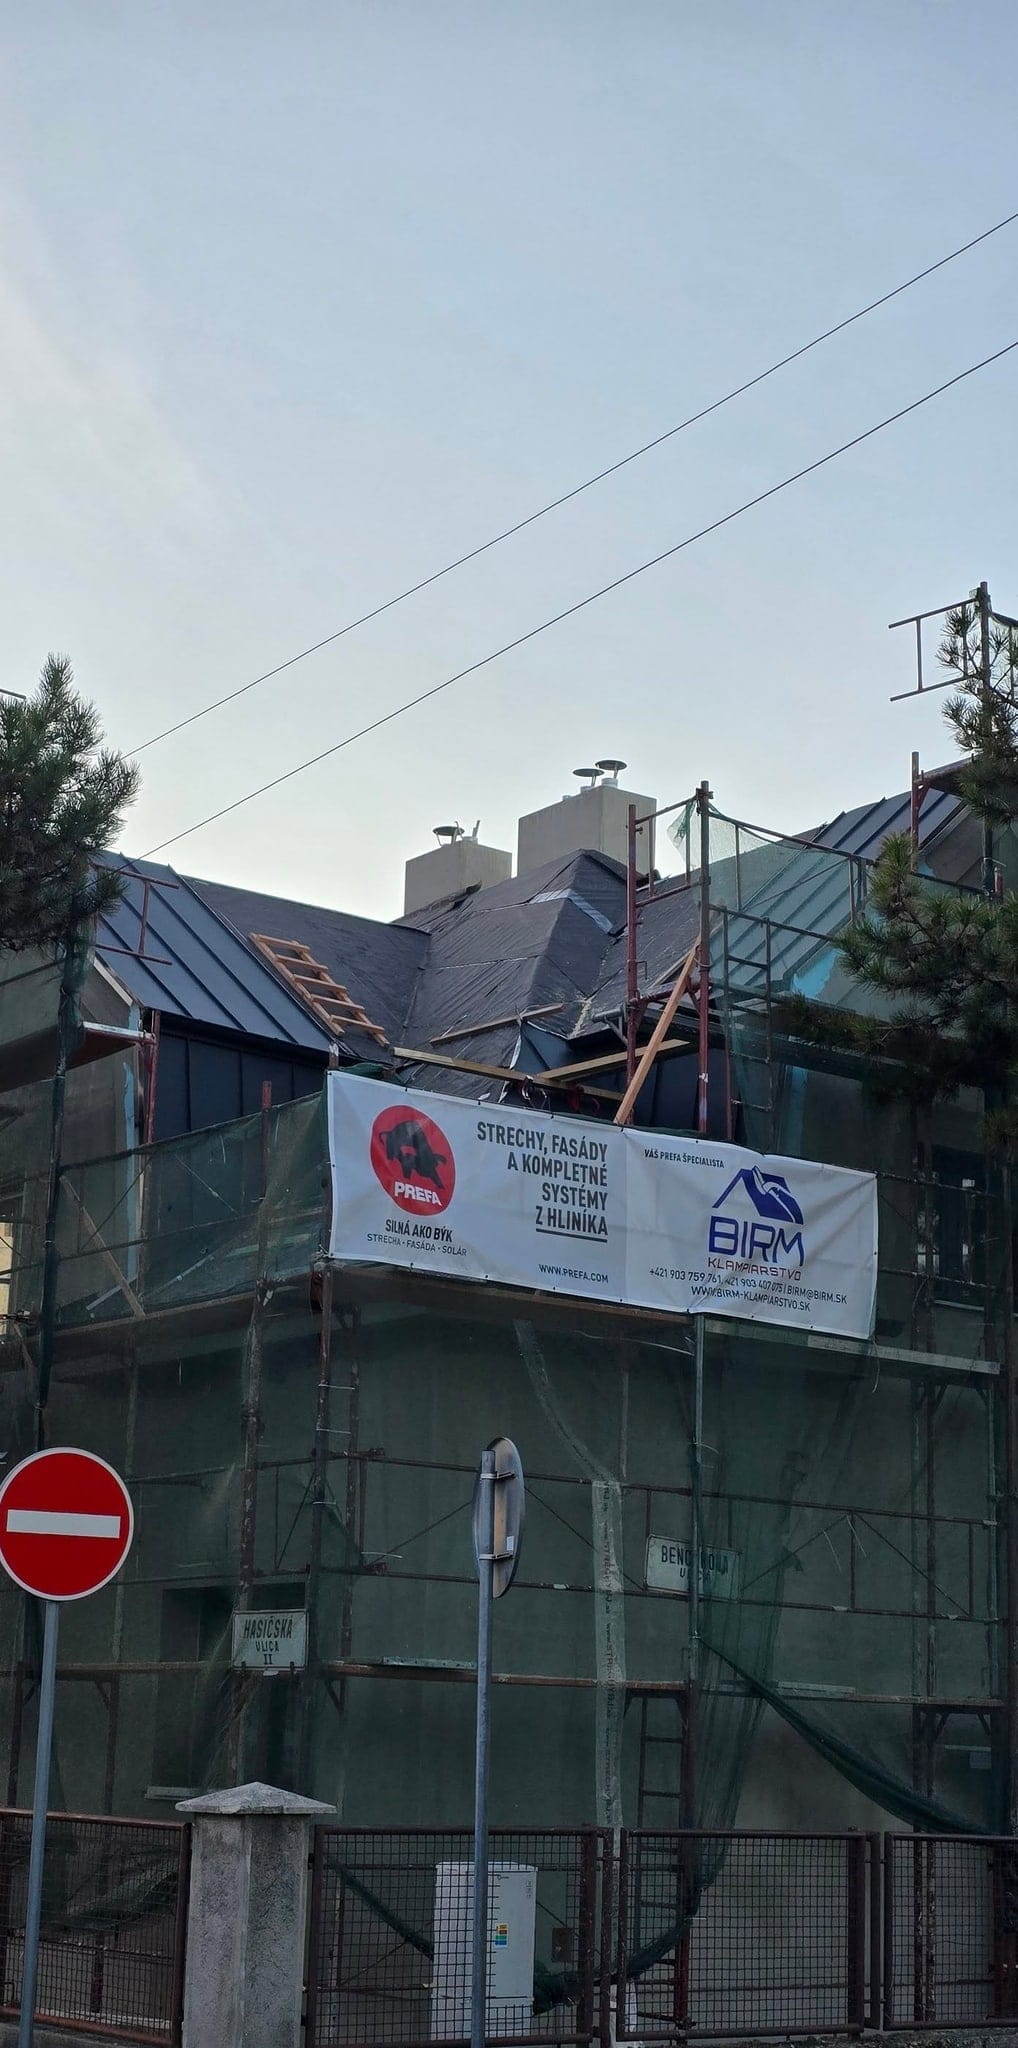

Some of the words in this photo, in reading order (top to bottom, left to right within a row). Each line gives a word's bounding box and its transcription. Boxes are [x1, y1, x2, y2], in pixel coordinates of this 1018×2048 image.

[477, 1121, 548, 1155] STRECHY,
[552, 1134, 608, 1162] FASÁDY
[507, 1151, 518, 1171] A
[522, 1153, 608, 1187] KOMPLETNÉ
[660, 1151, 681, 1162] PREFA
[682, 1152, 725, 1169] ŠPECIALISTA
[394, 1181, 443, 1206] PREFA
[542, 1182, 608, 1211] SYSTÉMY
[385, 1218, 410, 1237] SILNÁ
[412, 1224, 432, 1239] AKO
[433, 1226, 453, 1243] BÝK
[535, 1205, 543, 1225] Z
[547, 1207, 608, 1236] HLINÍKA
[367, 1233, 401, 1246] STRECHA
[406, 1238, 436, 1252] FASÁDA
[442, 1244, 467, 1257] SOLÁR
[708, 1215, 805, 1267] BIRM
[538, 1263, 609, 1283] WWW.PREFA.COM
[707, 1256, 802, 1281] KLAMPIARSTVO
[649, 1266, 668, 1278] +421
[669, 1269, 686, 1281] 903
[688, 1271, 706, 1282] 759
[740, 1278, 757, 1288] 903
[787, 1284, 847, 1305] BIRM@BIRM.SK
[243, 1615, 293, 1639] HASIČSKÁ
[255, 1640, 279, 1652] ULICA
[263, 1653, 273, 1665] II
